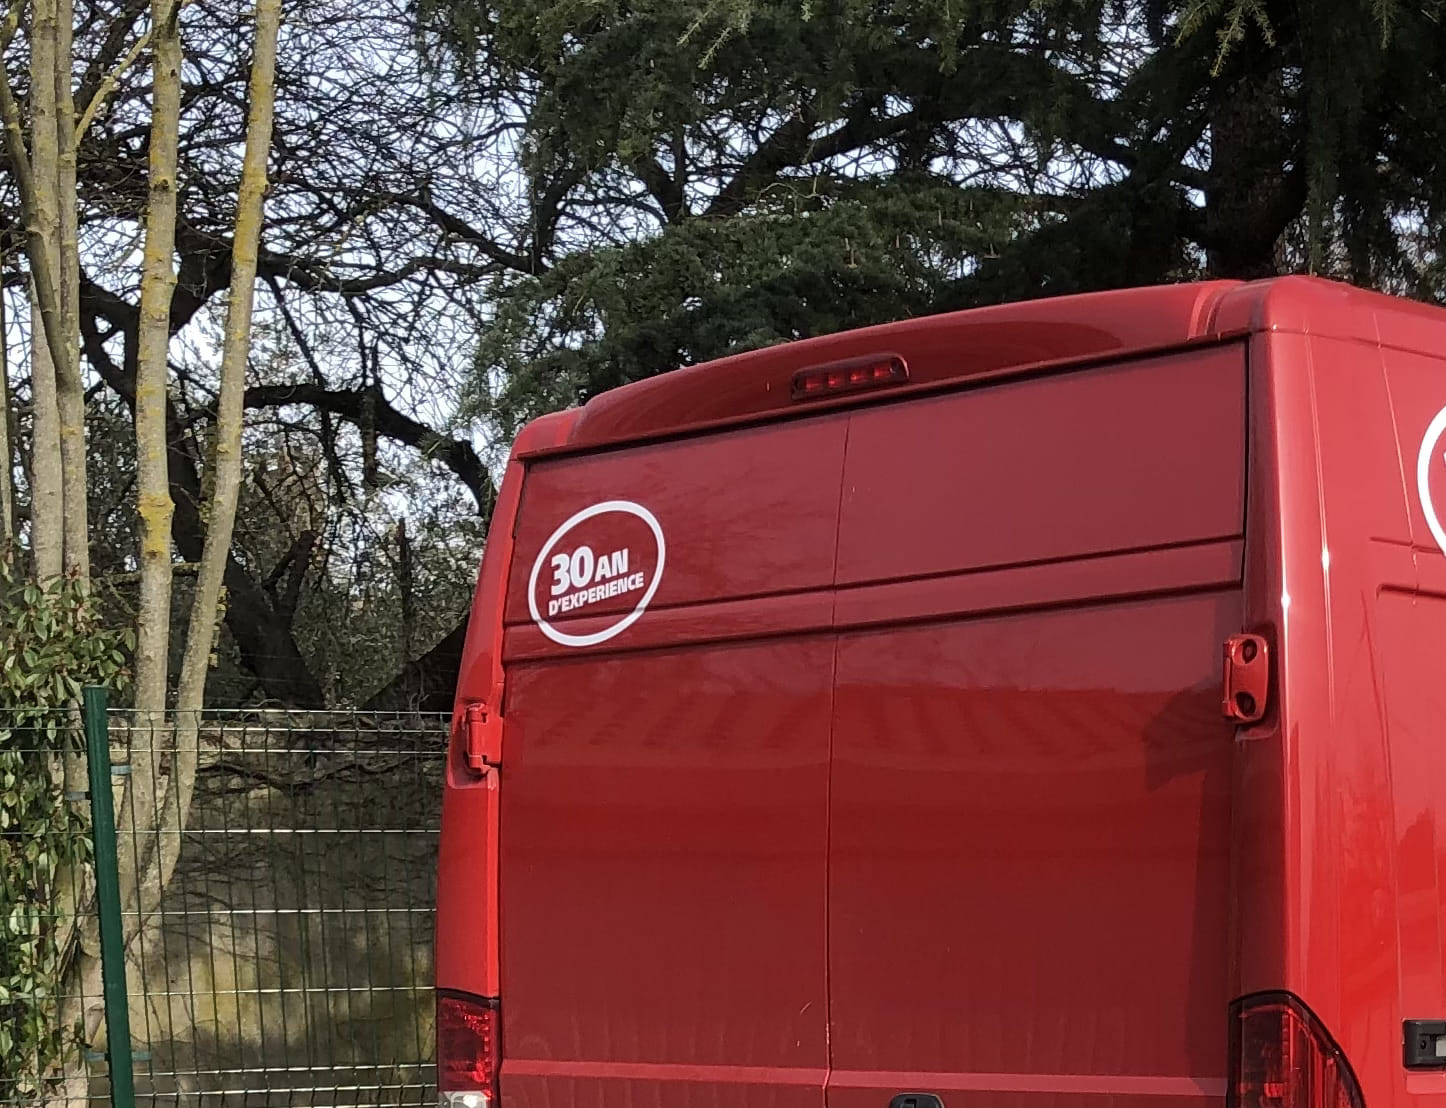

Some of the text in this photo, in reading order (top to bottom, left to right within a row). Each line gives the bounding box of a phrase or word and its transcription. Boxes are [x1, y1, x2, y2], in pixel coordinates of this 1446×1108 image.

[548, 571, 645, 617] D'EXPERIENCE
[551, 545, 629, 596] 30 AN
